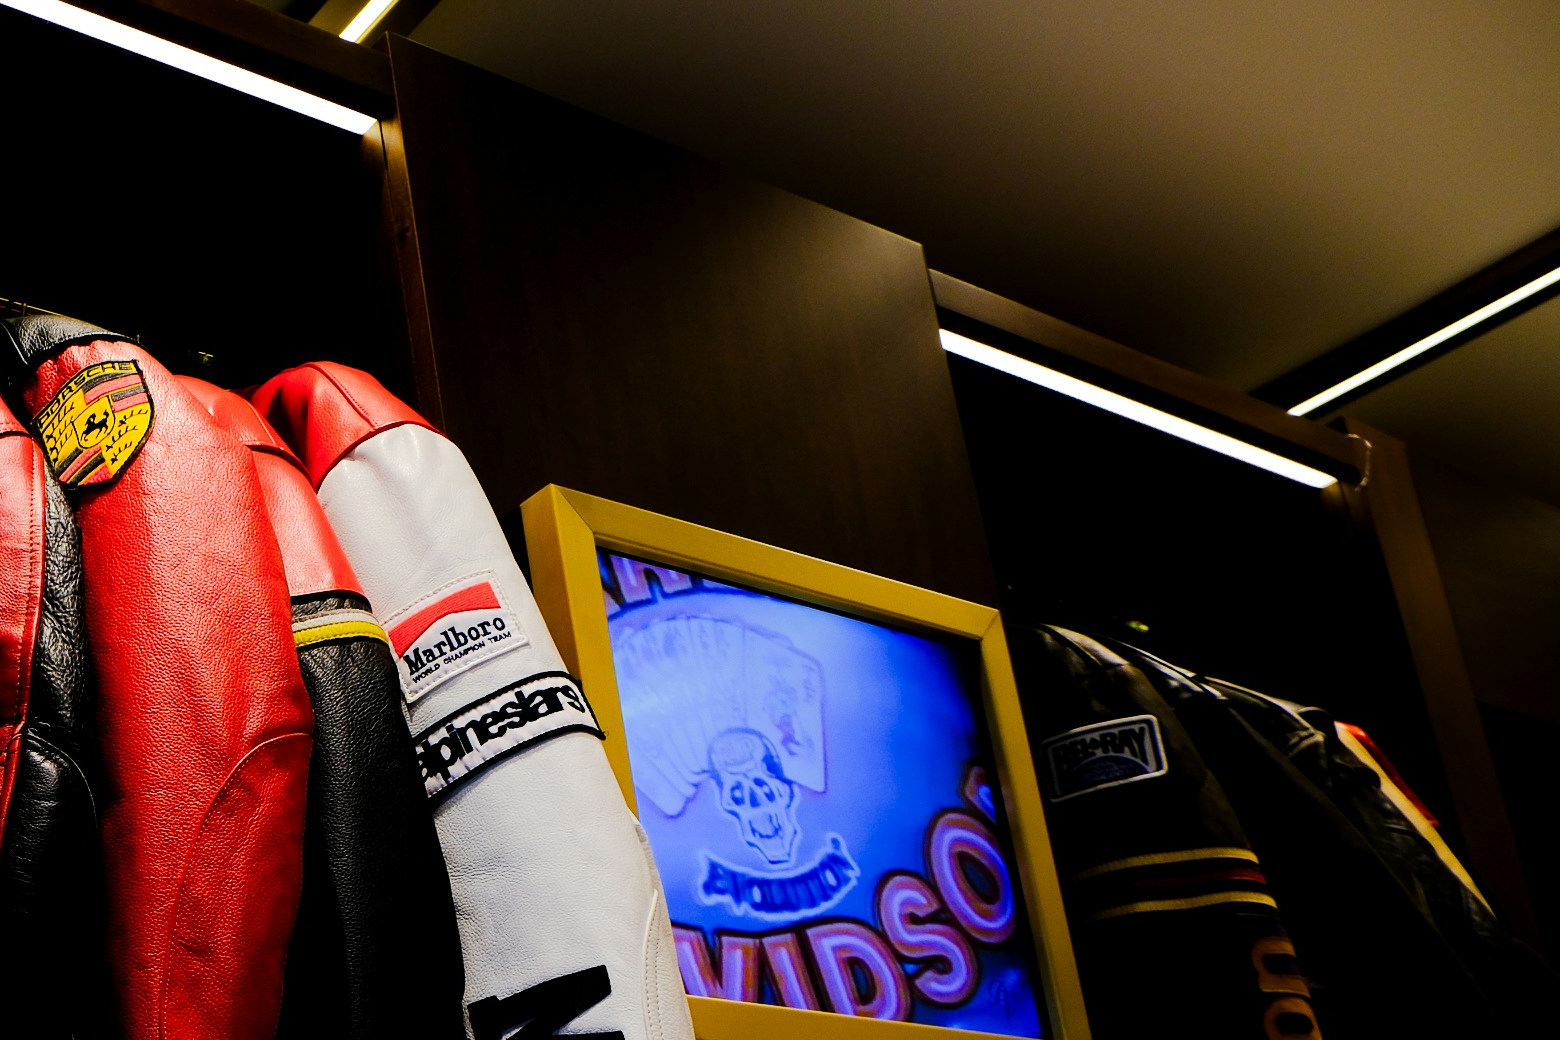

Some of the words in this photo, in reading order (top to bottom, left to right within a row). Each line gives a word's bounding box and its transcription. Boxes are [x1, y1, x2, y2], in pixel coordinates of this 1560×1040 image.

[37, 361, 132, 429] PORSCHE
[403, 616, 506, 676] Marlboro
[412, 662, 441, 684] WORLD
[443, 641, 486, 665] CHAMPION
[488, 631, 512, 645] TEAM
